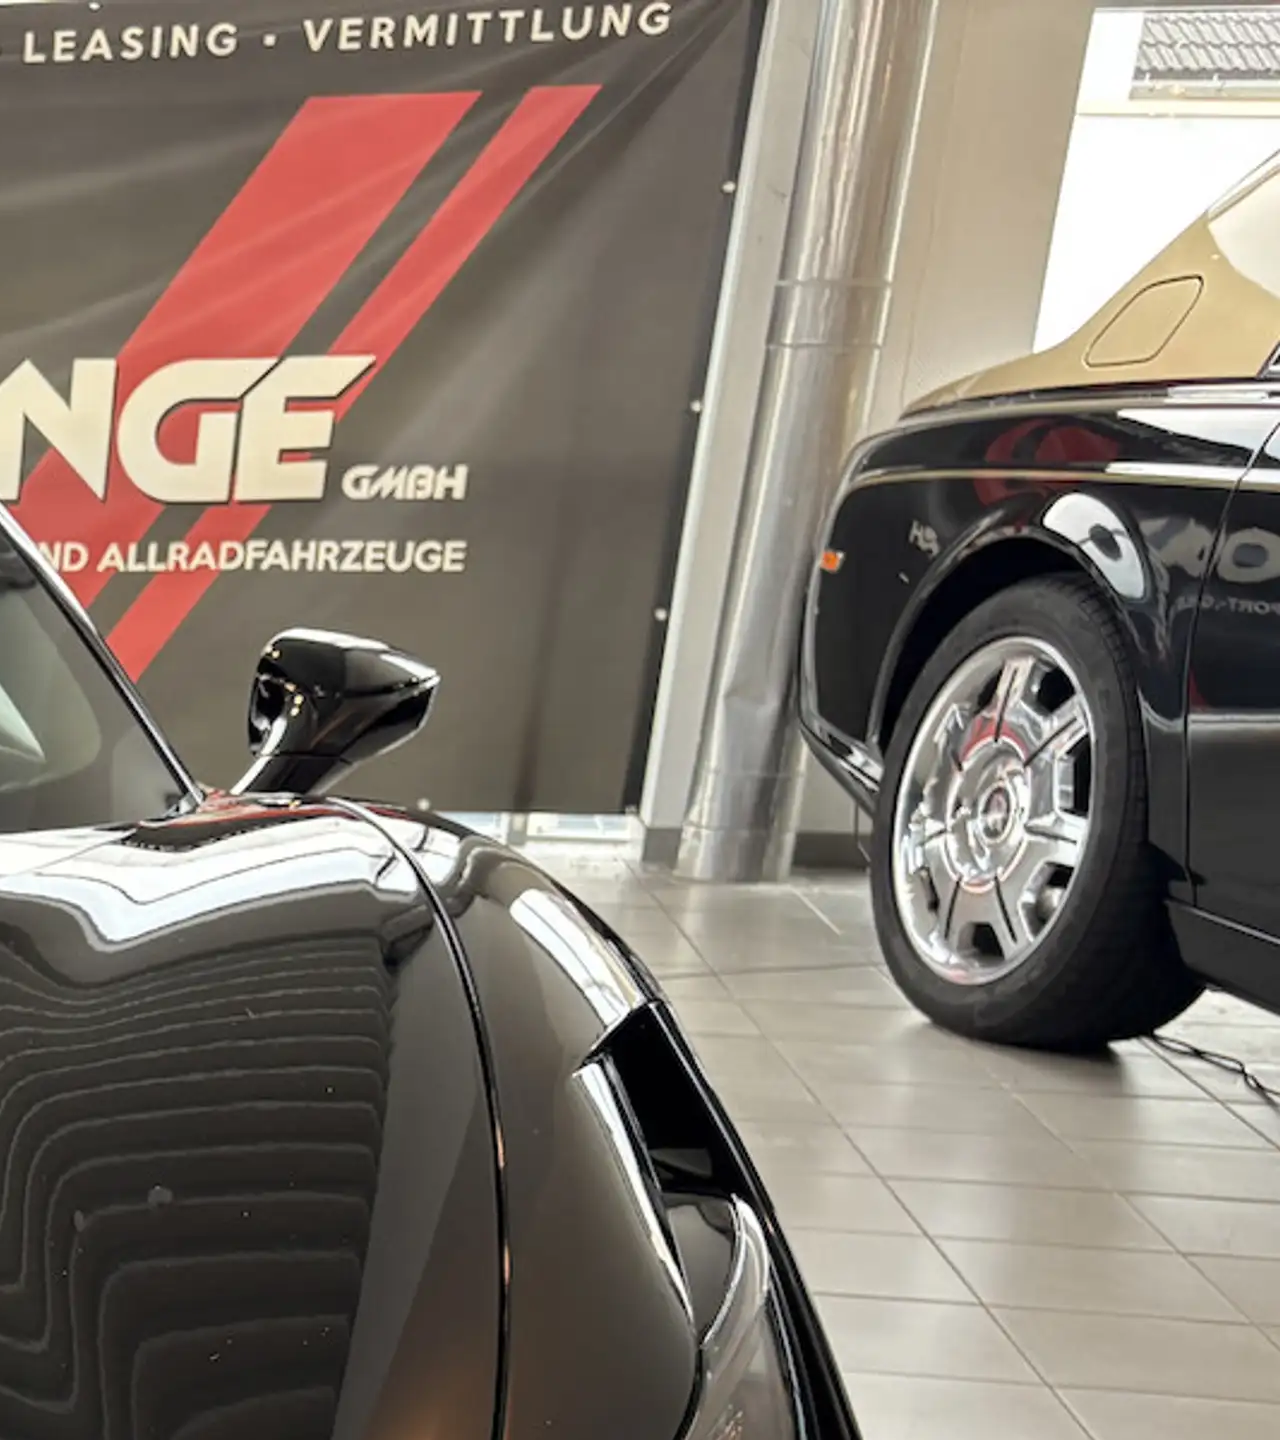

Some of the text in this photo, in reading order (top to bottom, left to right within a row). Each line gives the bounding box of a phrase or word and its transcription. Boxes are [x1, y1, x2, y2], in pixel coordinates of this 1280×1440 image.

[23, 23, 238, 64] LEASING
[303, 3, 673, 53] VERMITTLUNG
[341, 464, 469, 501] GMBH
[96, 539, 468, 574] ALLRADFAHRZEUGE
